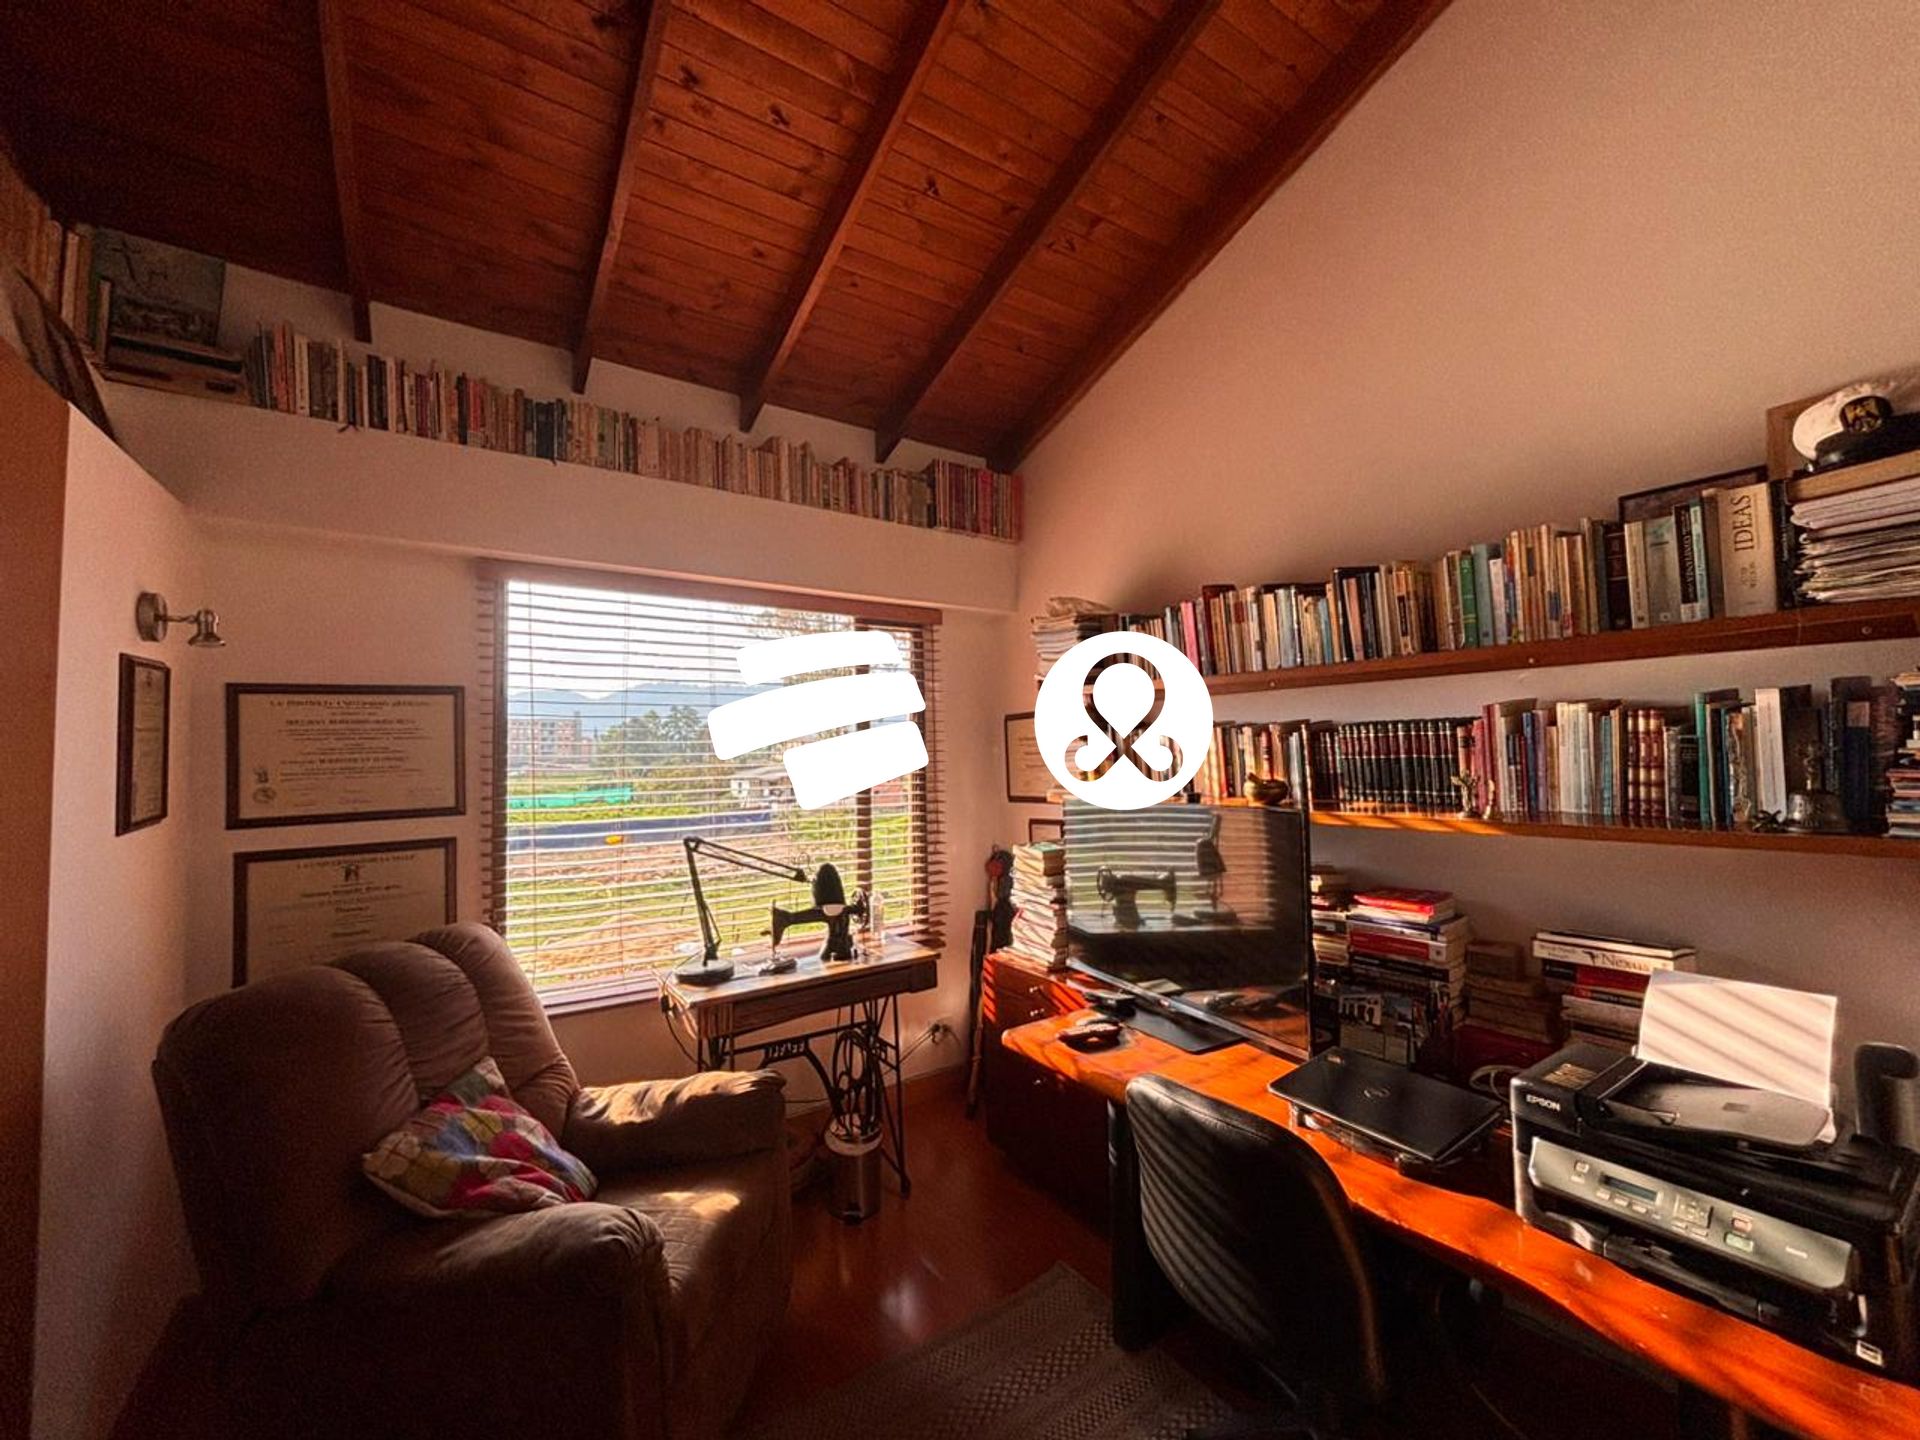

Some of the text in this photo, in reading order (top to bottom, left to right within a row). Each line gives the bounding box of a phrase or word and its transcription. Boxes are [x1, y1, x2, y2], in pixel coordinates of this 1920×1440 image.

[1731, 494, 1754, 552] IDEAS
[1601, 953, 1649, 972] Nexus
[1526, 1094, 1560, 1112] EPSON
